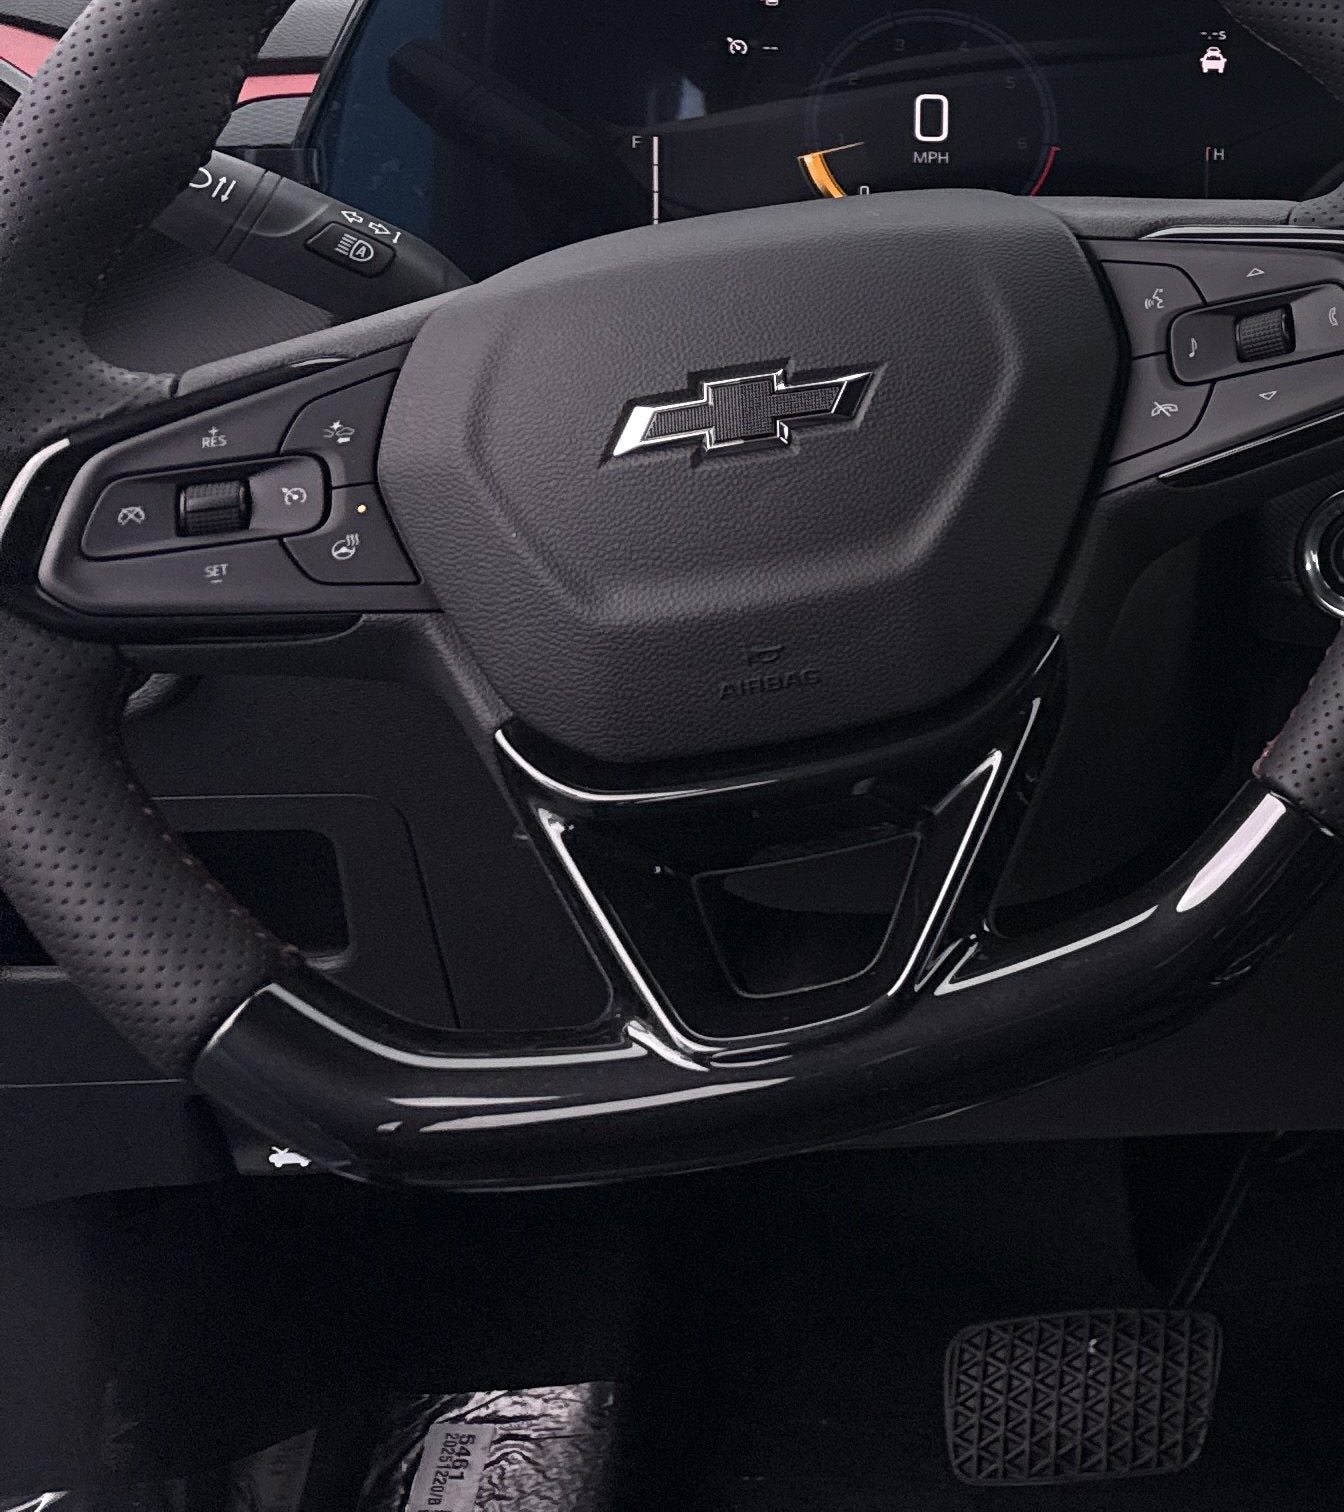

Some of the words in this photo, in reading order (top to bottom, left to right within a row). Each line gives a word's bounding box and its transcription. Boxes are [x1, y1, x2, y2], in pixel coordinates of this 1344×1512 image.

[914, 93, 949, 143] 0
[631, 135, 643, 149] F
[912, 151, 949, 165] MPH
[1213, 148, 1225, 161] H
[202, 434, 227, 448] RES
[204, 563, 229, 578] SET
[720, 668, 822, 701] AIRBAG
[448, 1434, 476, 1480] 5461
